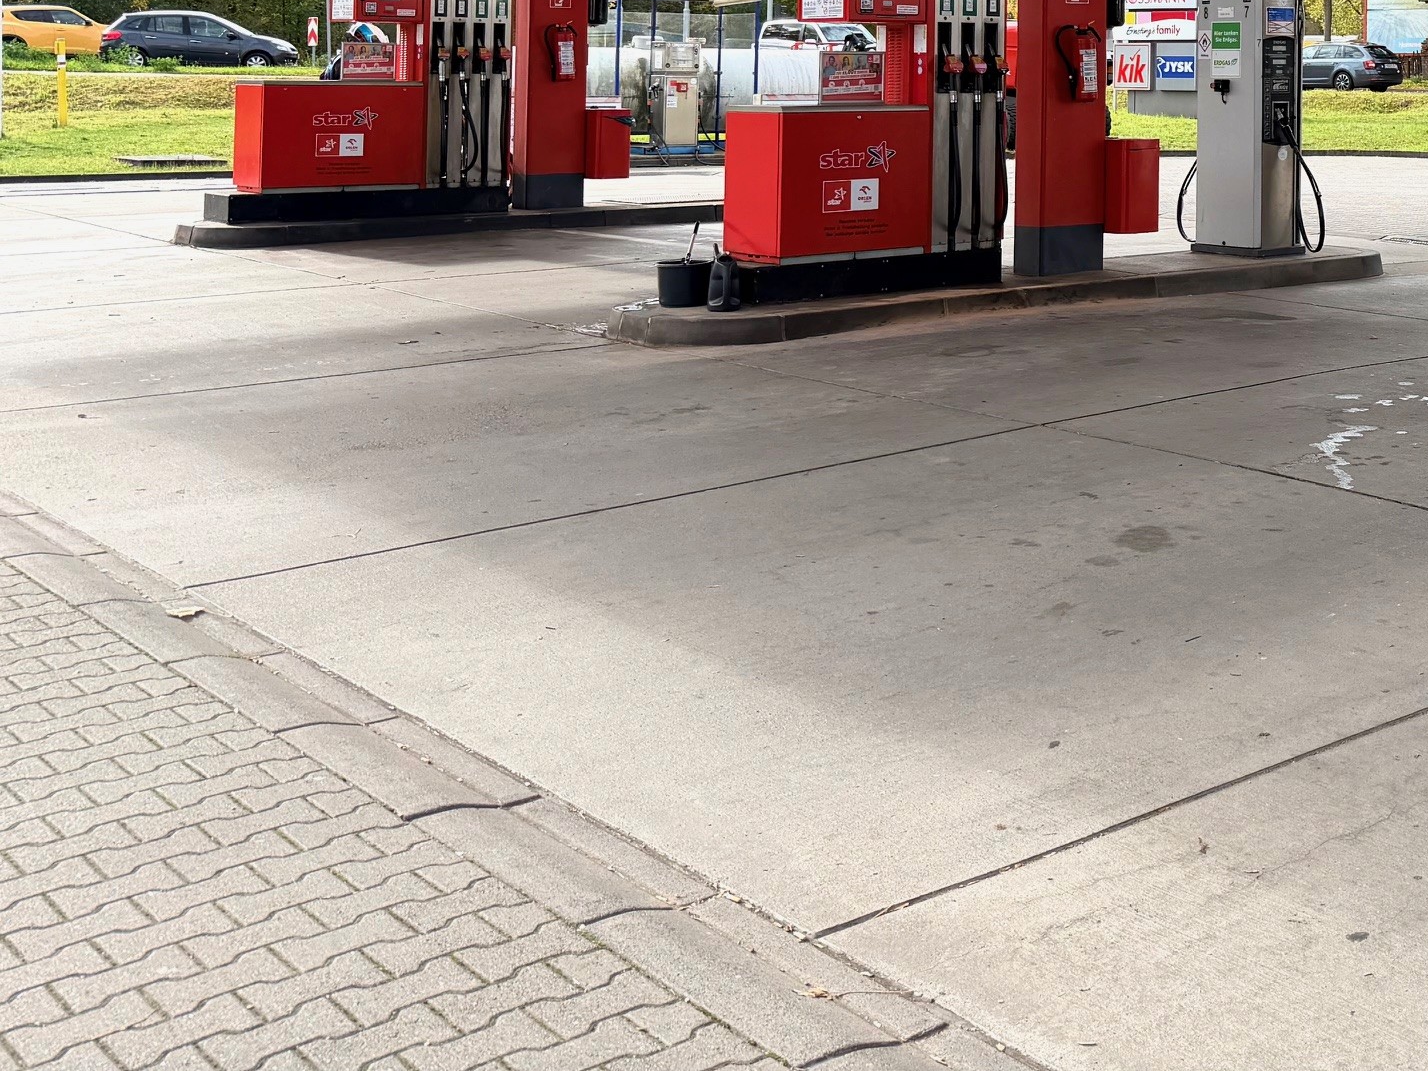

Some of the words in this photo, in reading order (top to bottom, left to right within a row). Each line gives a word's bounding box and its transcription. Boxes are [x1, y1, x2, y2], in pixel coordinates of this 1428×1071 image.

[1203, 6, 1209, 20] 8
[1244, 5, 1250, 18] 7
[1156, 24, 1181, 36] family
[1163, 61, 1194, 73] JYSK
[312, 111, 352, 127] star
[819, 148, 865, 169] star
